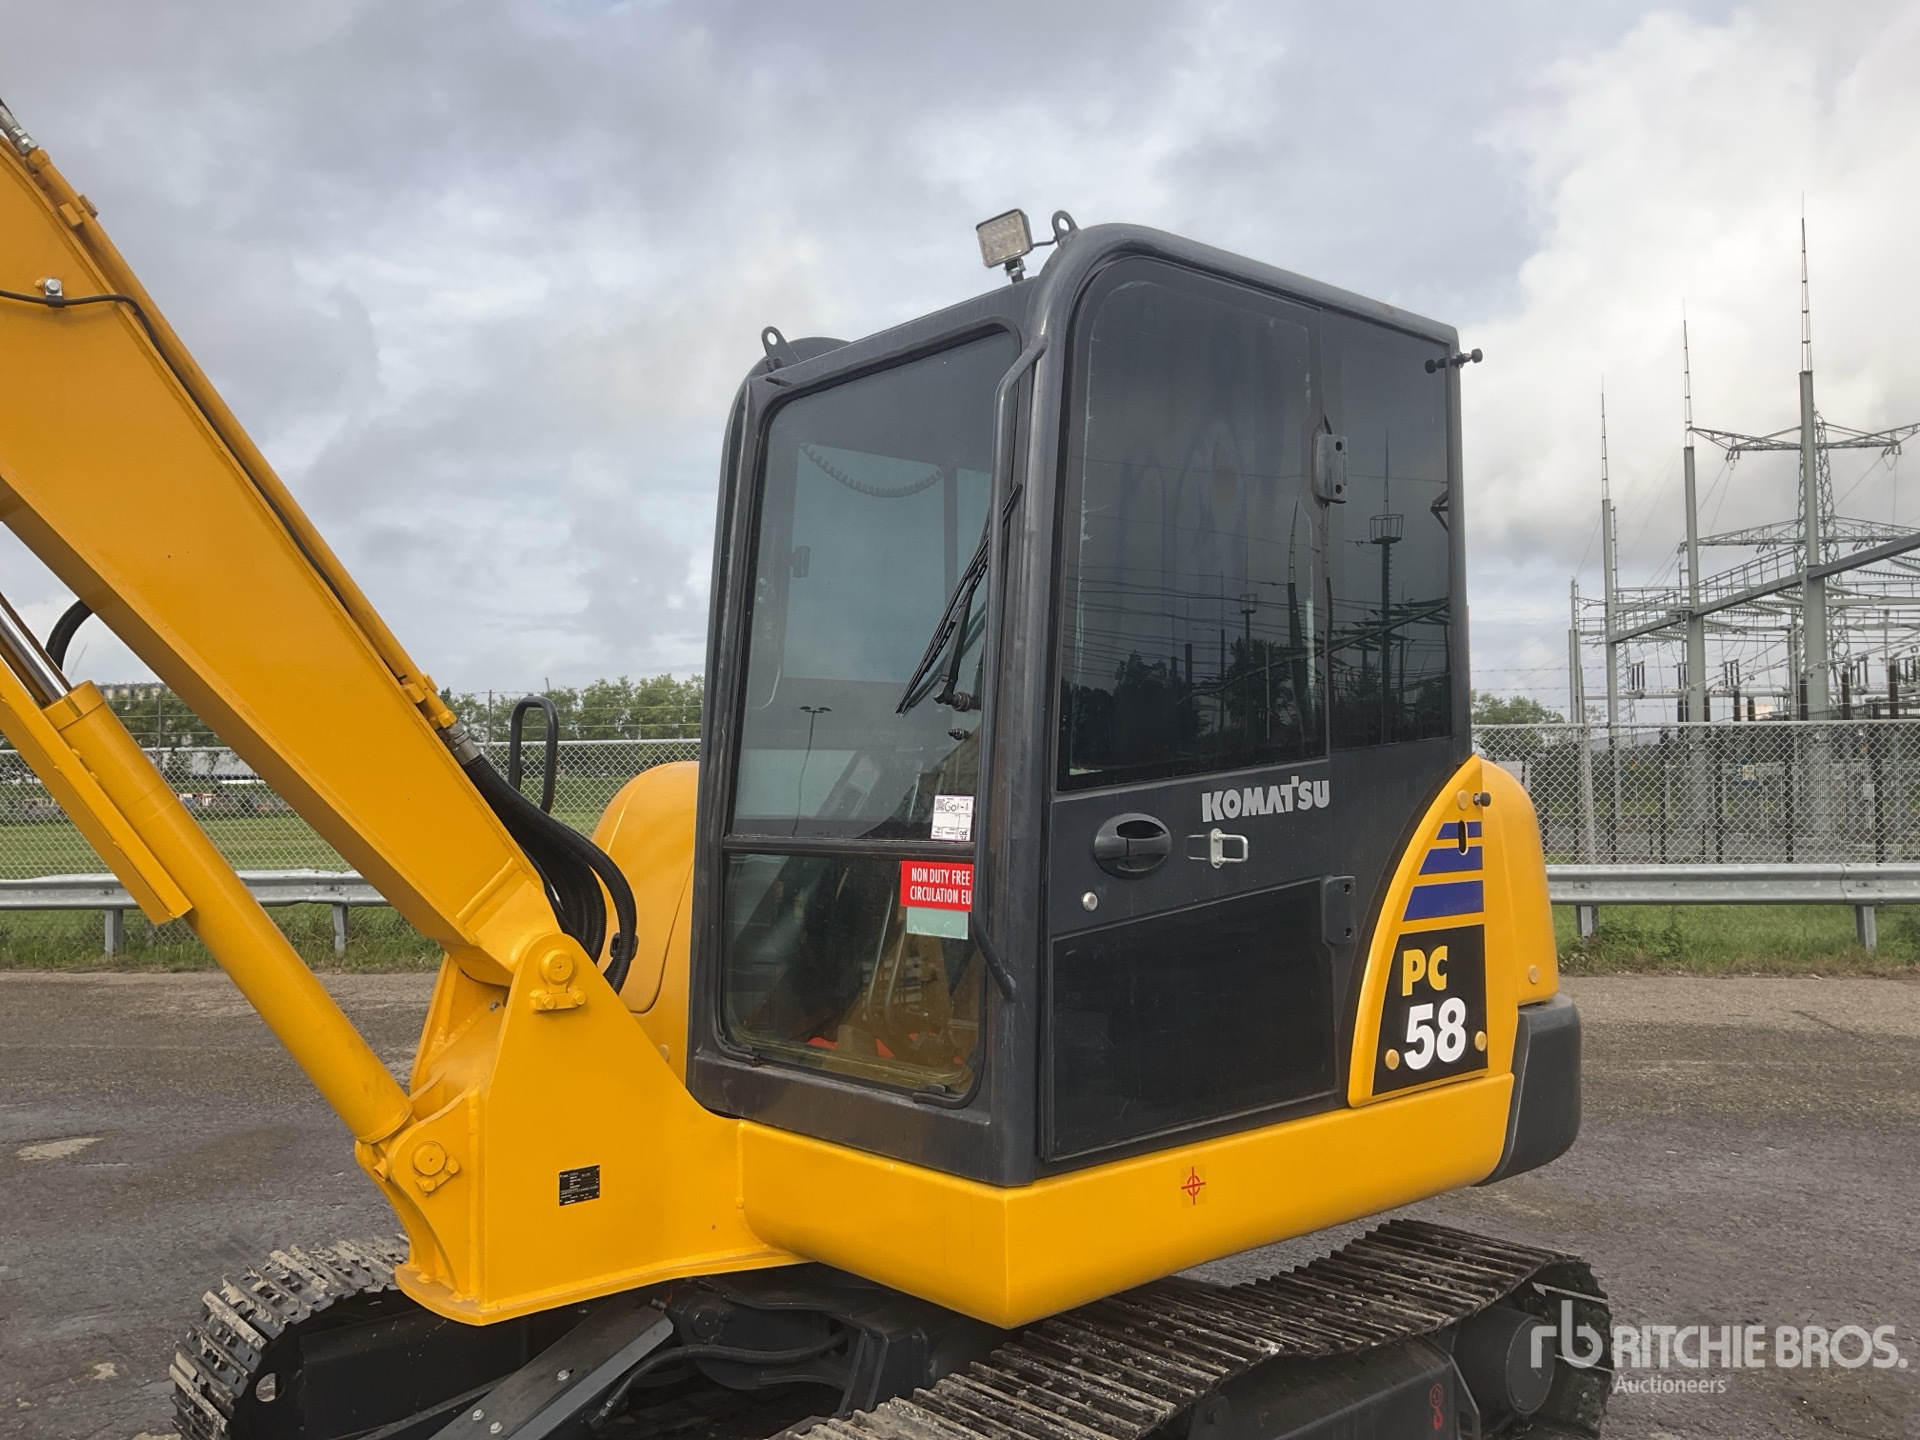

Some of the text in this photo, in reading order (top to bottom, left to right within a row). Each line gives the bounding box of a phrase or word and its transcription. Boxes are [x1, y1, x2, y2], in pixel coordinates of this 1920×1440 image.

[1201, 776, 1330, 822] KOMATSU
[910, 885, 972, 905] CIRCULATION EU
[911, 867, 971, 886] NON DUTY FREE
[1402, 945, 1449, 997] PC
[1404, 997, 1467, 1070] 58
